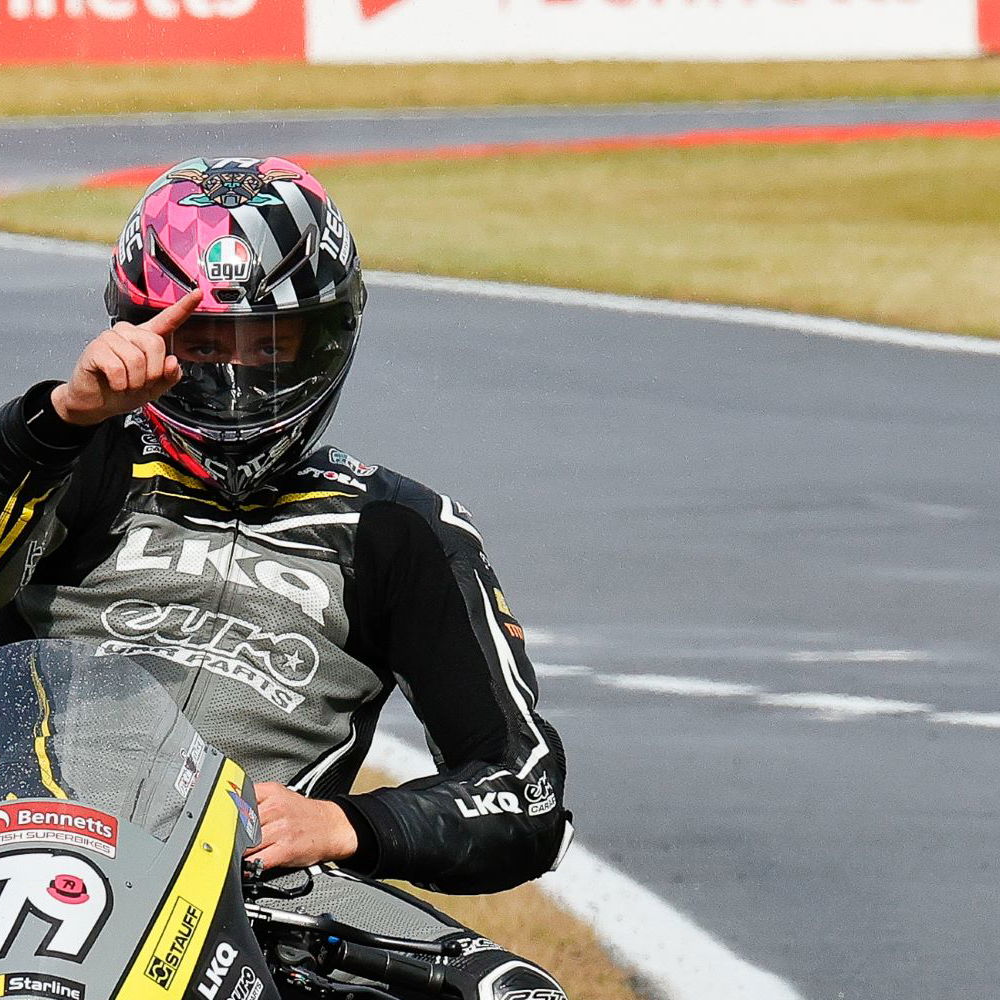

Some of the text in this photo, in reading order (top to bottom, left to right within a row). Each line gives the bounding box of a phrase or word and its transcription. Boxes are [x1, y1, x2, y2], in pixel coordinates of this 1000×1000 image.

[210, 262, 246, 281] agv
[116, 527, 330, 627] LKQ
[185, 653, 294, 709] PARTS
[454, 791, 523, 818] LKQ
[17, 808, 113, 838] Bennetts
[26, 831, 111, 854] SUPERBIKES
[165, 905, 198, 967] STAUFF
[8, 976, 81, 1000] Starline
